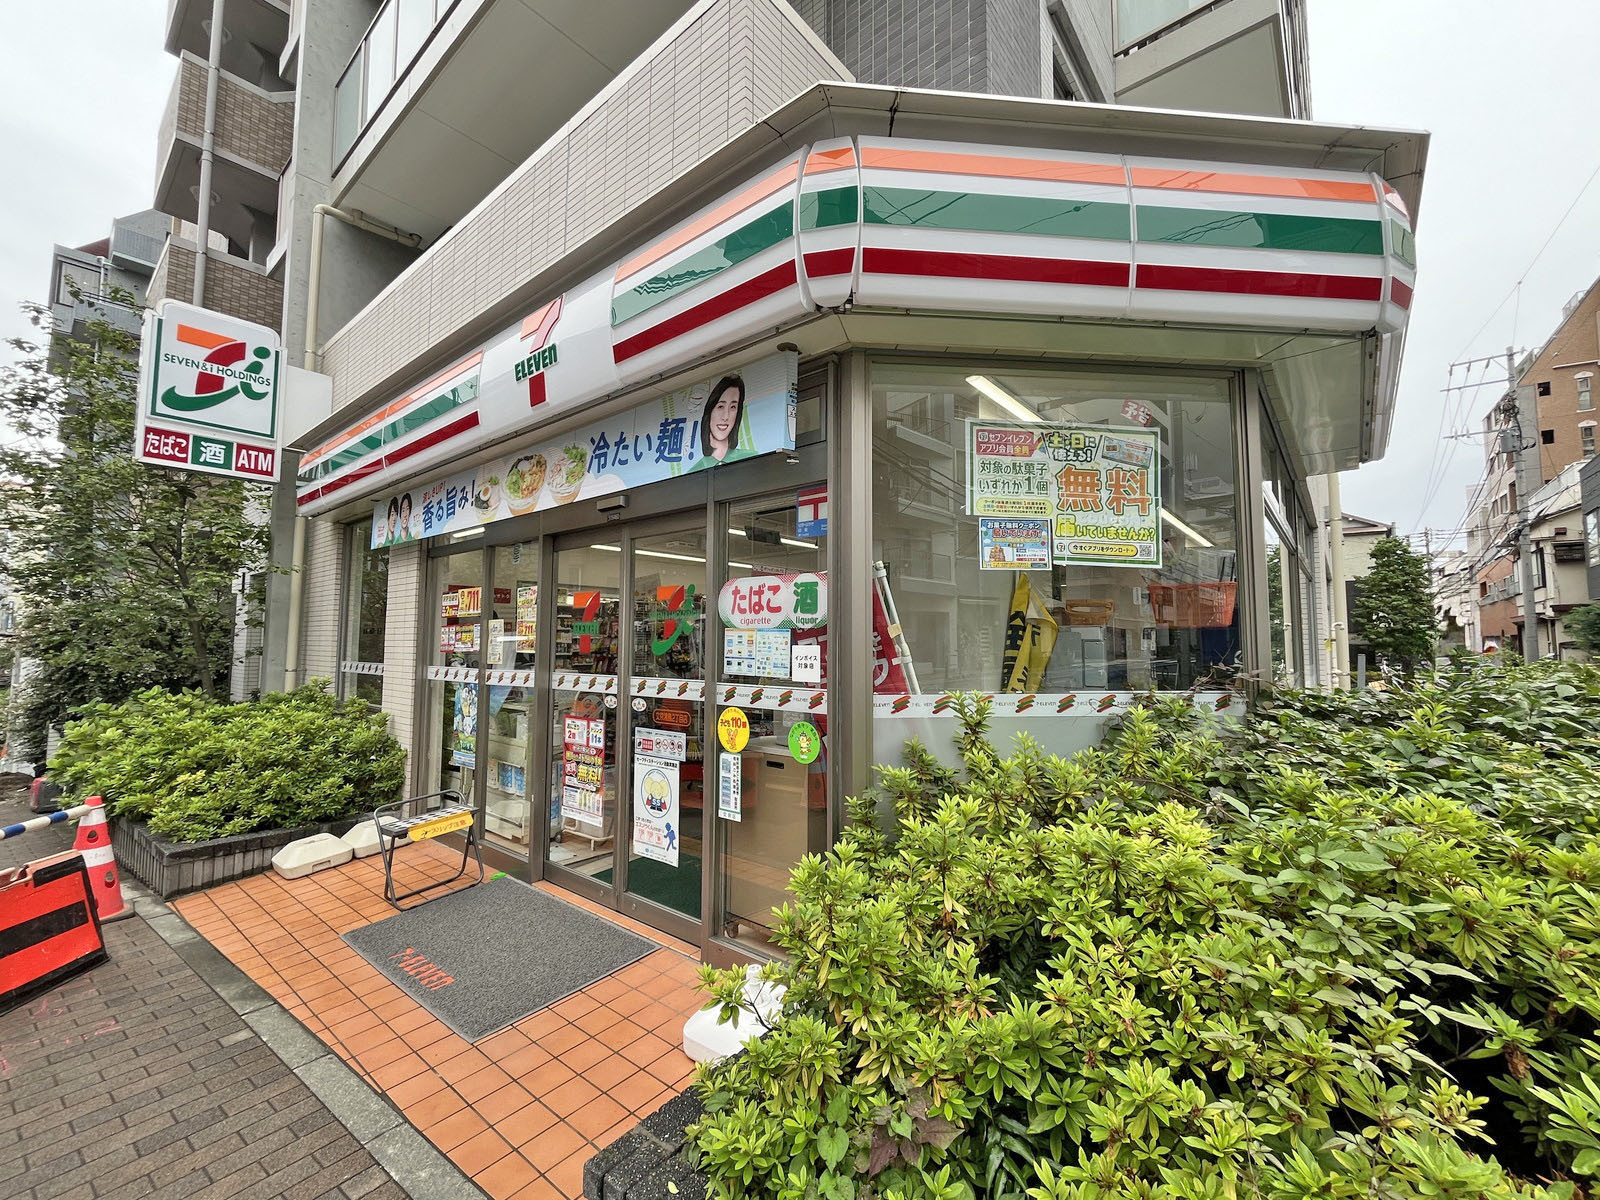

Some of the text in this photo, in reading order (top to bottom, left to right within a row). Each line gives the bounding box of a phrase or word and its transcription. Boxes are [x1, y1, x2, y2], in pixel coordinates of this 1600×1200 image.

[216, 366, 271, 387] HOLDINGS
[145, 432, 187, 458] たばこ
[200, 441, 225, 465] 酒
[237, 448, 273, 472] ATM
[980, 460, 1048, 476] 対象の駄菓子
[979, 476, 1049, 496] いずれか1個
[1056, 464, 1153, 516] 無料
[1056, 514, 1156, 542] 届いていませんか?
[731, 581, 819, 616] たばこ 酒
[740, 616, 772, 626] cigarette
[795, 615, 819, 626] liquor
